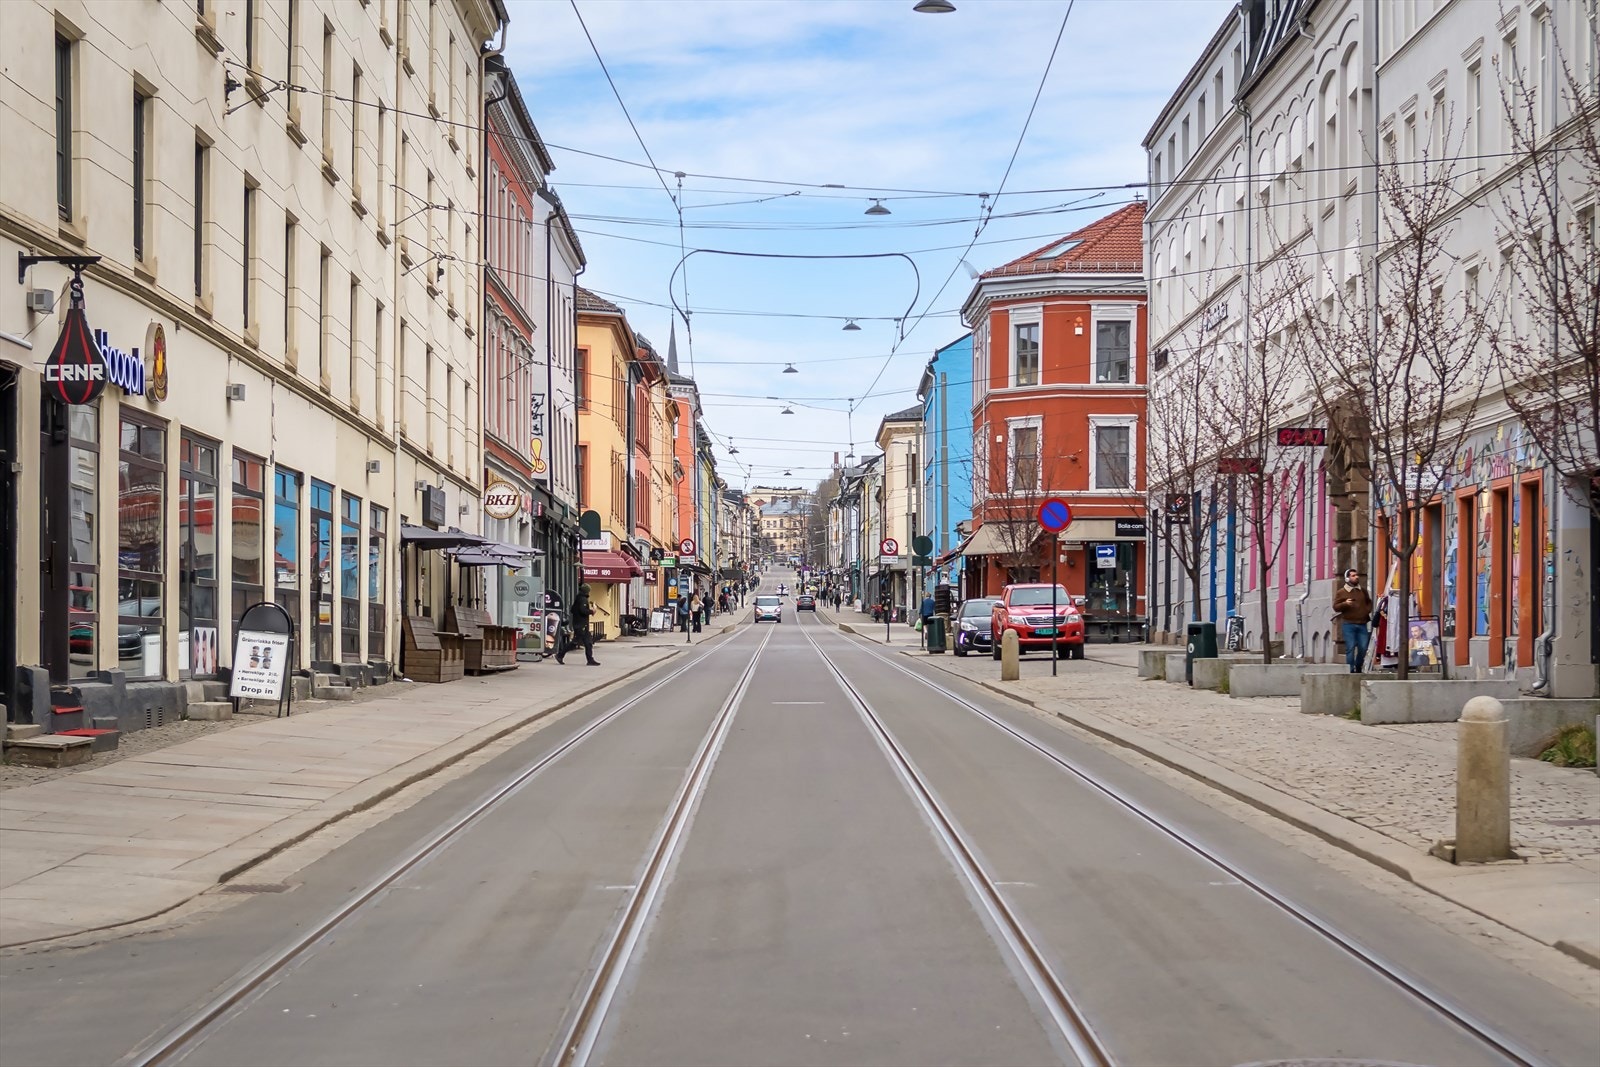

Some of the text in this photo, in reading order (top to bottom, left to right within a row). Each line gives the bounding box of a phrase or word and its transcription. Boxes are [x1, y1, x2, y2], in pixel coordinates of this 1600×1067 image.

[46, 364, 104, 381] CRNR
[484, 494, 518, 506] BKH
[241, 685, 262, 694] Drop
